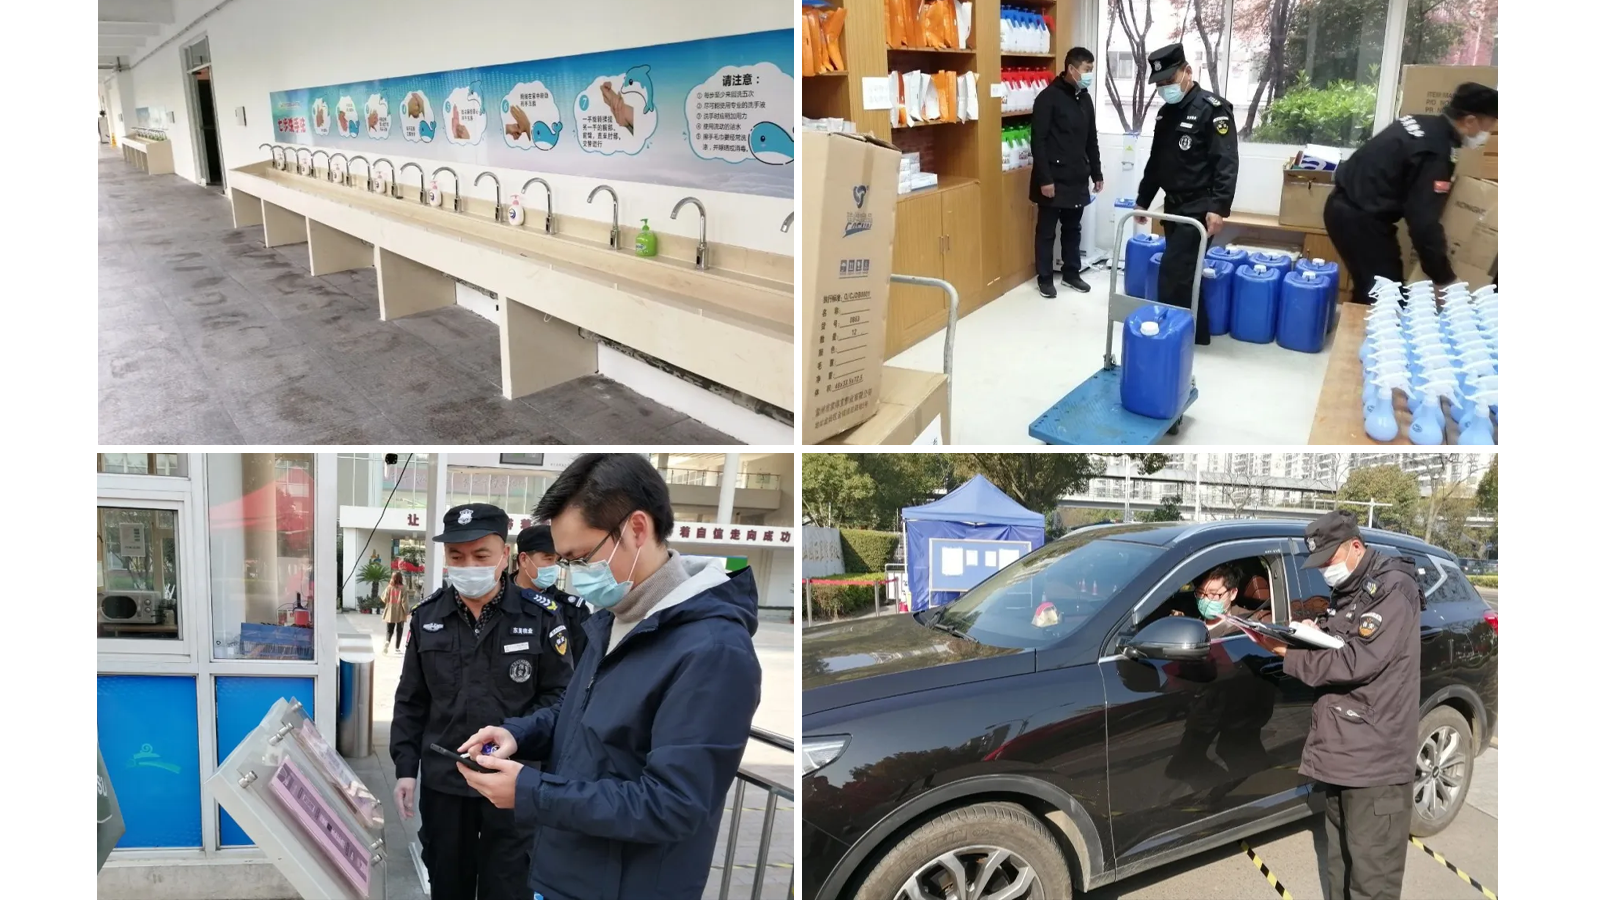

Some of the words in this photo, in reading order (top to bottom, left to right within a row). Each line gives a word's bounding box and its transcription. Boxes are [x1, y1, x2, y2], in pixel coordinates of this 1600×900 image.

[407, 513, 420, 526] 让
[679, 525, 792, 543] 着自信走向成功
